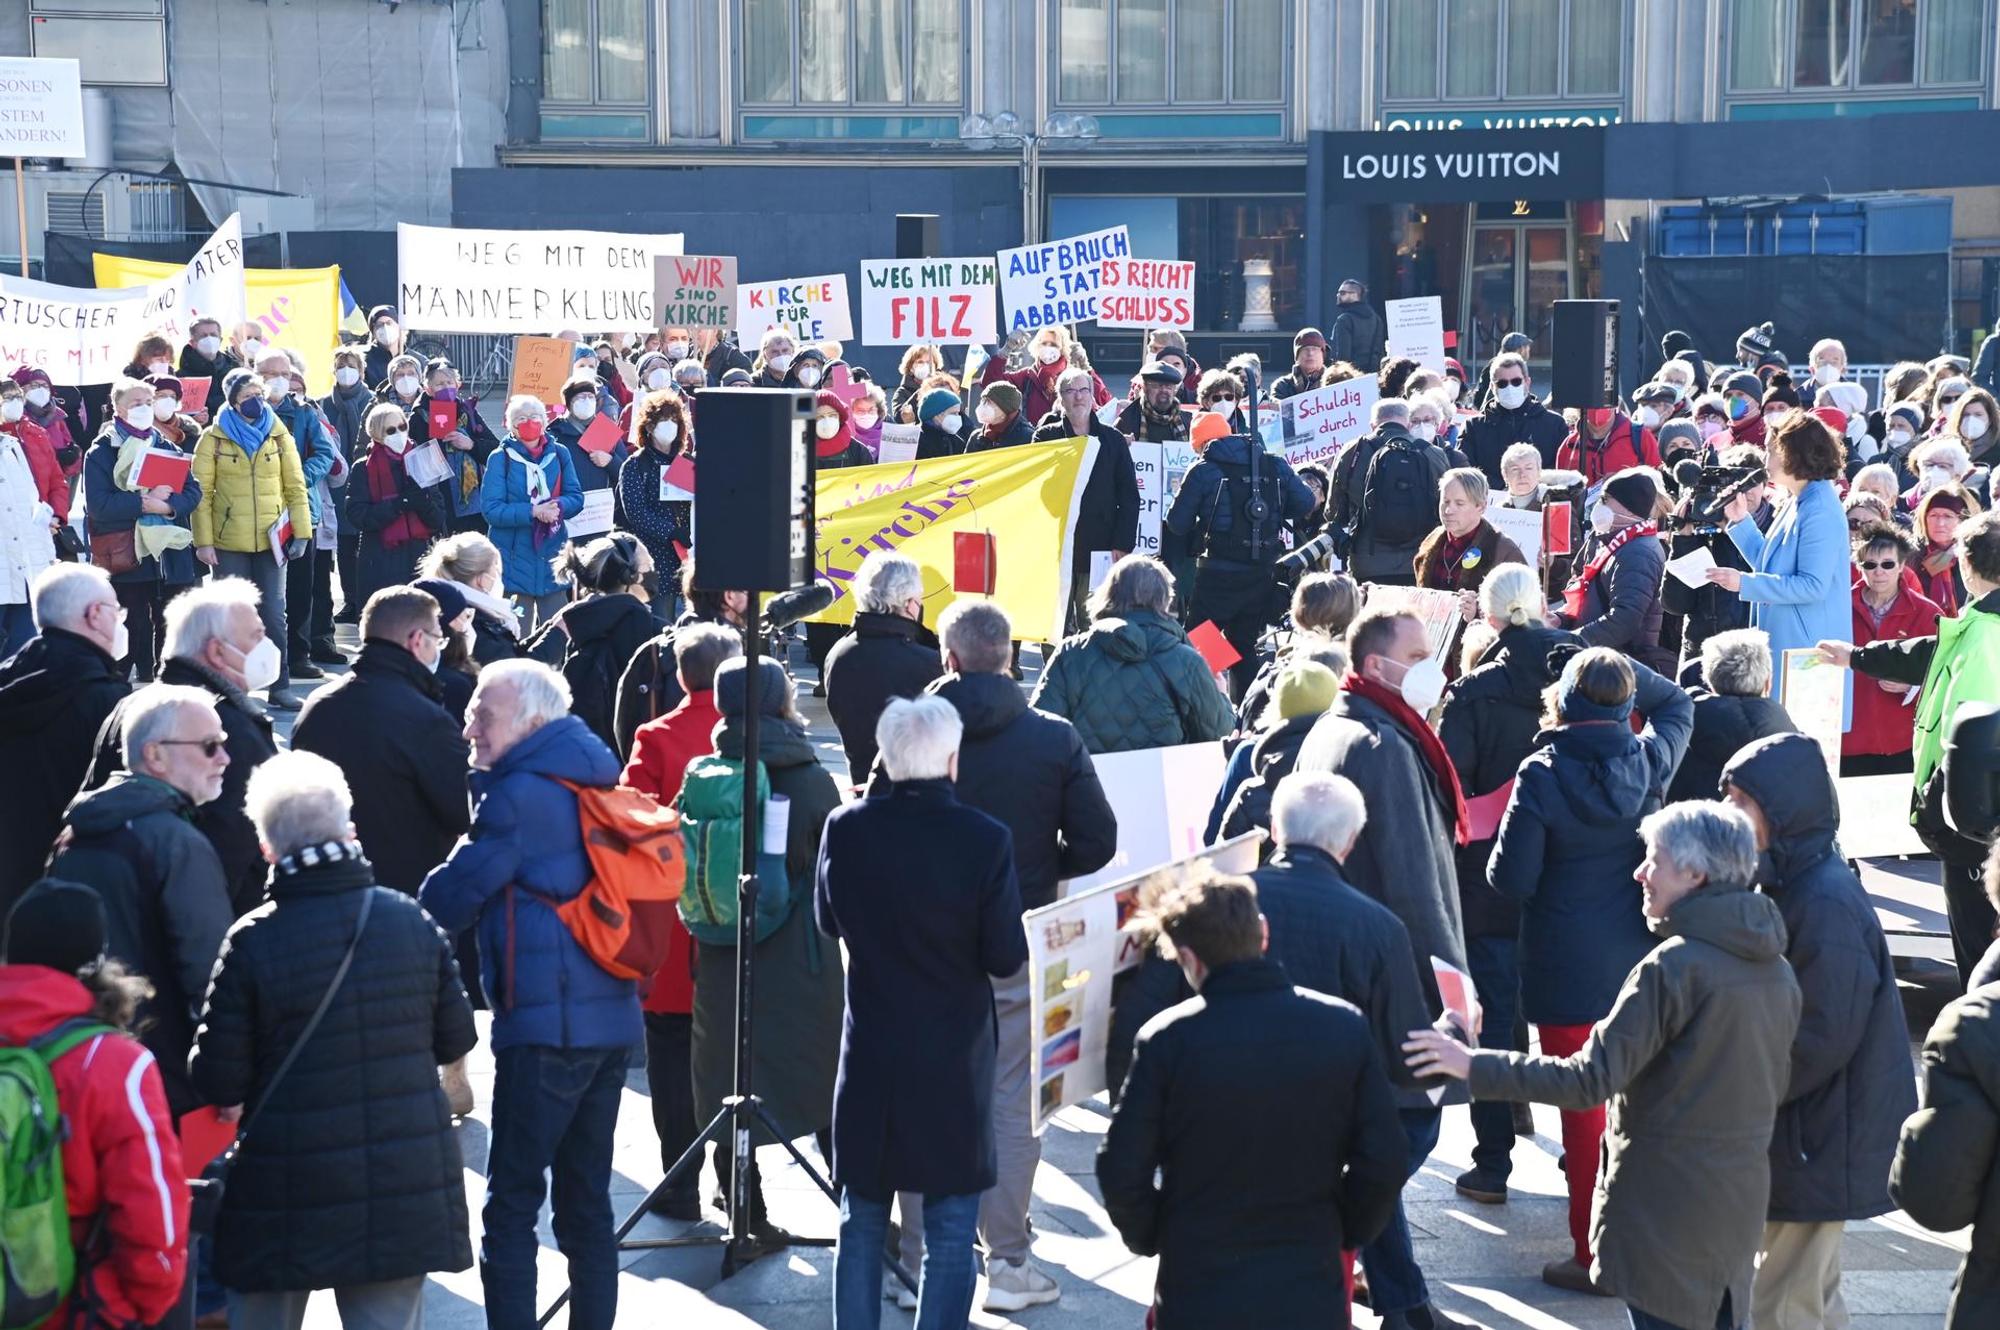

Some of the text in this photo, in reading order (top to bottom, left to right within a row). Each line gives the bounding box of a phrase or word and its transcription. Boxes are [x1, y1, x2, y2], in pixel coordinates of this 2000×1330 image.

[1343, 151, 1560, 179] LOUIS VUITTON
[458, 241, 648, 269] WEG MIT DEM
[1009, 231, 1128, 278] AUFBRUCH
[675, 257, 725, 288] WIR
[867, 263, 995, 289] WEG MIT DEM
[1101, 260, 1194, 290] ES REICHT
[674, 288, 717, 302] SIND
[750, 283, 832, 309] KIRCHE
[664, 303, 729, 326] KIRCHE
[777, 305, 810, 323] FÜR
[891, 294, 972, 339] FILZ
[1100, 296, 1191, 326] SCHLUSS
[2, 344, 111, 367] WEG MIT
[1298, 388, 1361, 420] Schuldig
[1319, 411, 1357, 433] durch
[1284, 436, 1344, 466] Vertusch
